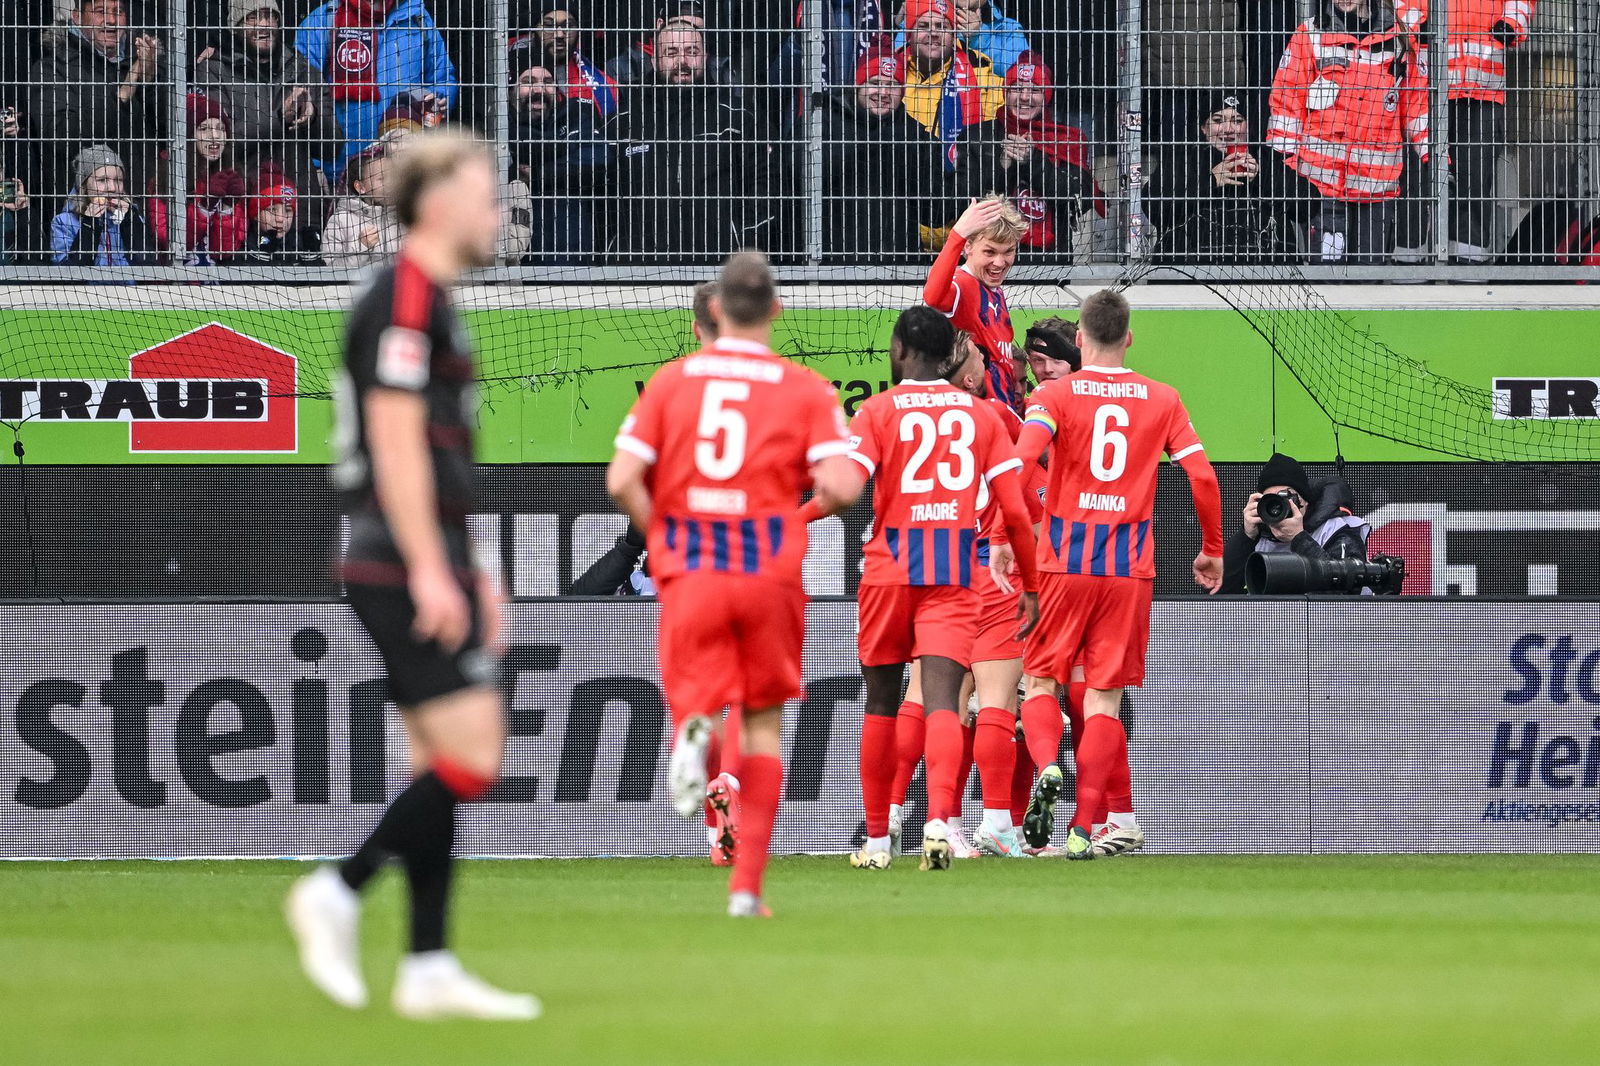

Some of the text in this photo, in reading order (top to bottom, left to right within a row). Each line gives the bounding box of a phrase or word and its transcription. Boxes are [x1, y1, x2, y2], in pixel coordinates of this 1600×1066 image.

[0, 381, 264, 419] TRAUB
[892, 391, 974, 410] HEIDENHEIM
[1071, 379, 1148, 400] HEIDENHEIM
[1496, 380, 1599, 417] TR
[694, 380, 750, 481] 5
[1090, 403, 1130, 482] 6
[900, 409, 975, 494] 23
[911, 499, 958, 522] TRAORÉ
[1078, 492, 1126, 512] MAINKA
